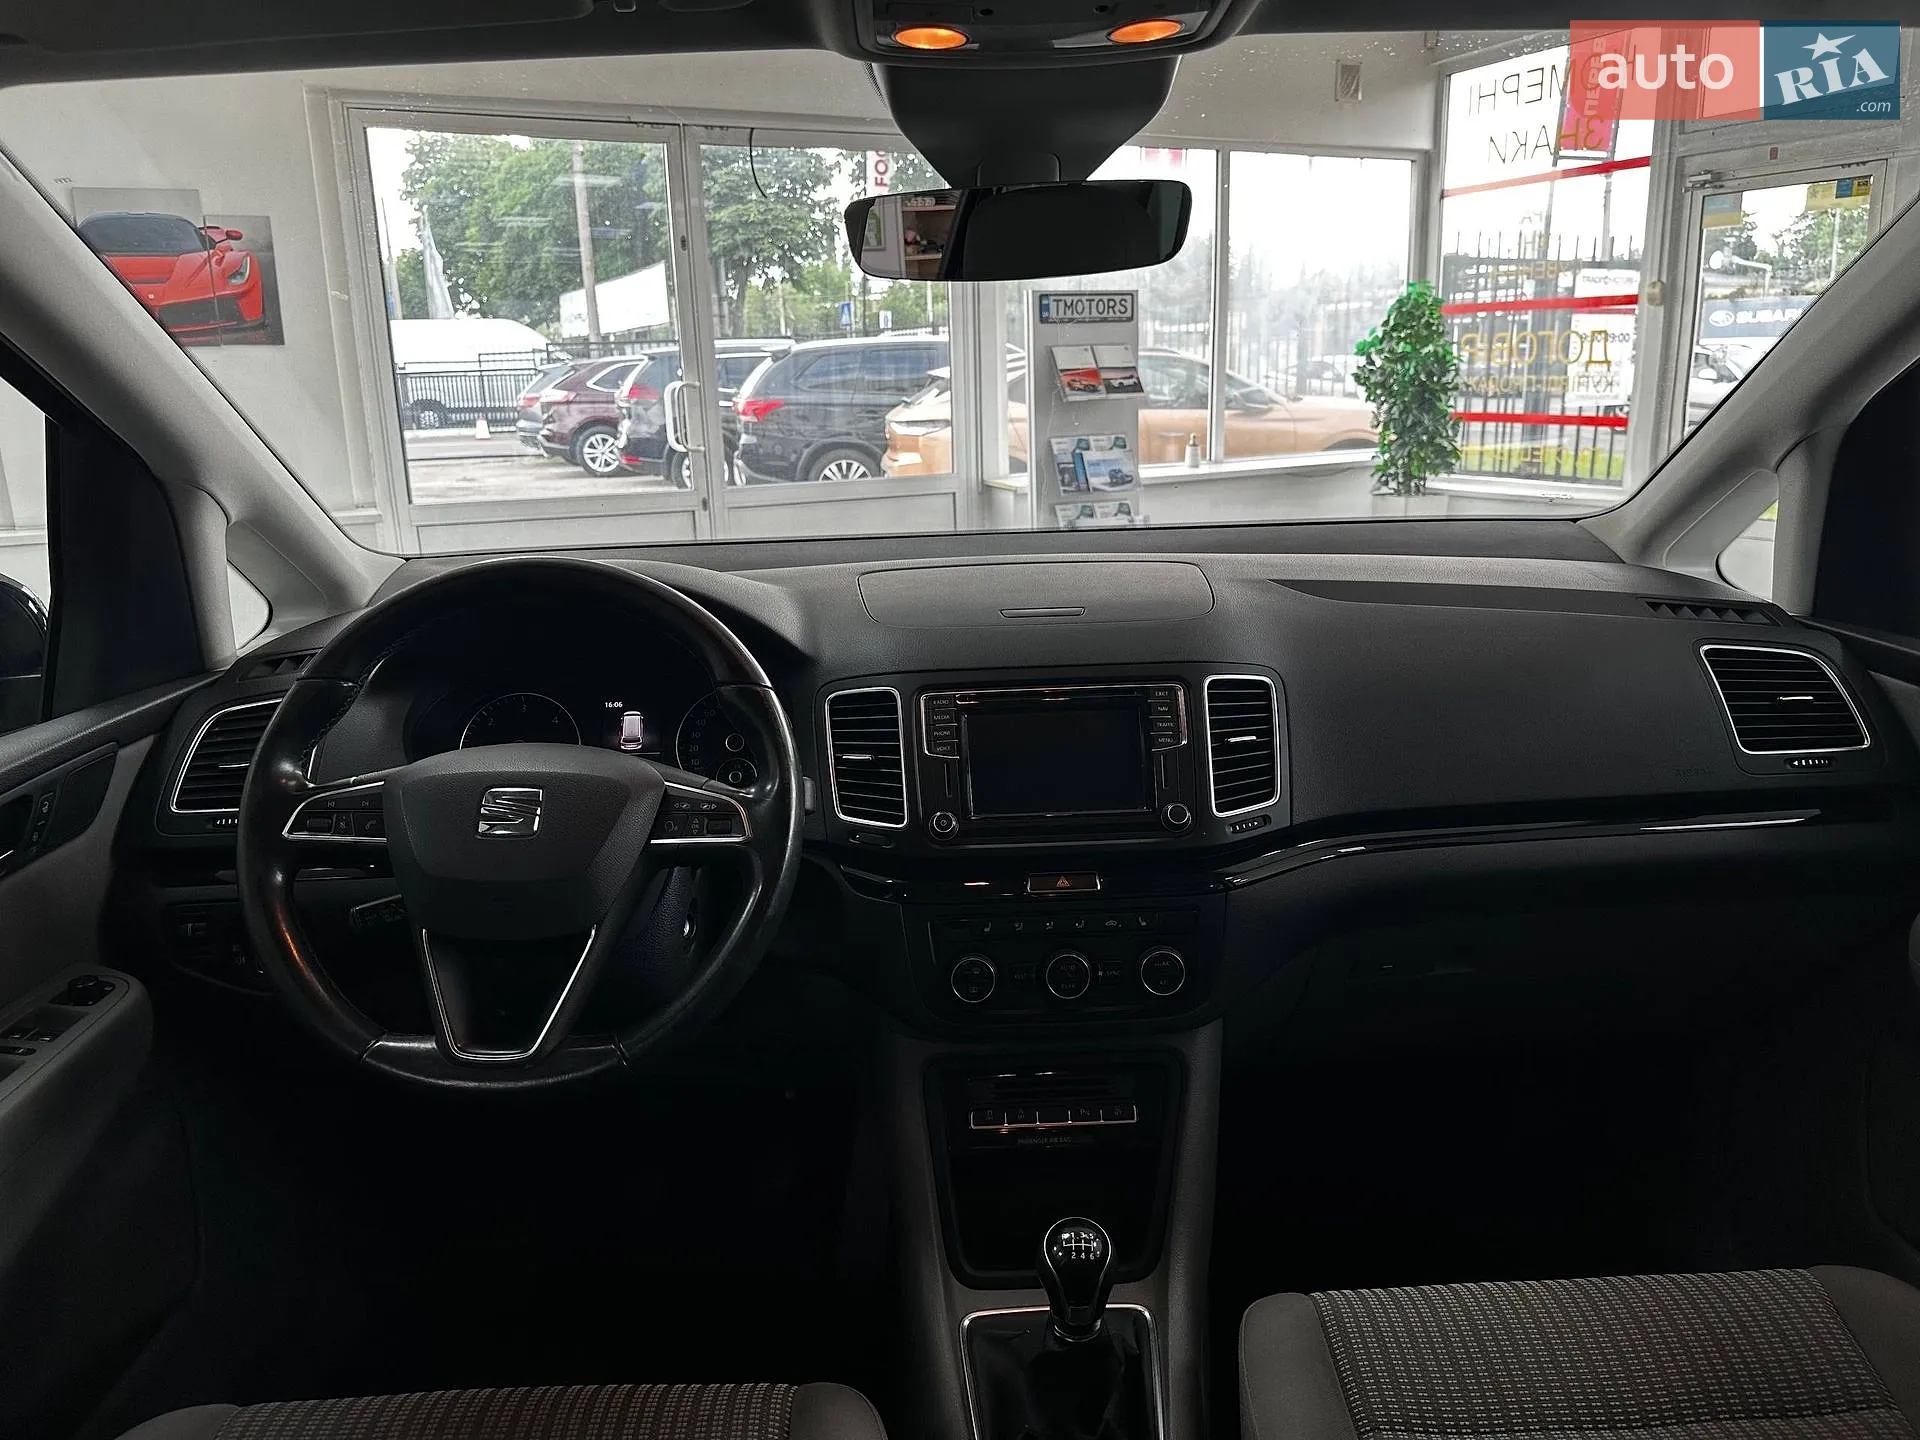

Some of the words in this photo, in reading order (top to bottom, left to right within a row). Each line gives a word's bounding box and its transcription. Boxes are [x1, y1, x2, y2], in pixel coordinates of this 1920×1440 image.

[1052, 298, 1128, 316] TMOTORS
[1736, 308, 1804, 324] SUBAR
[604, 701, 624, 709] 16:06
